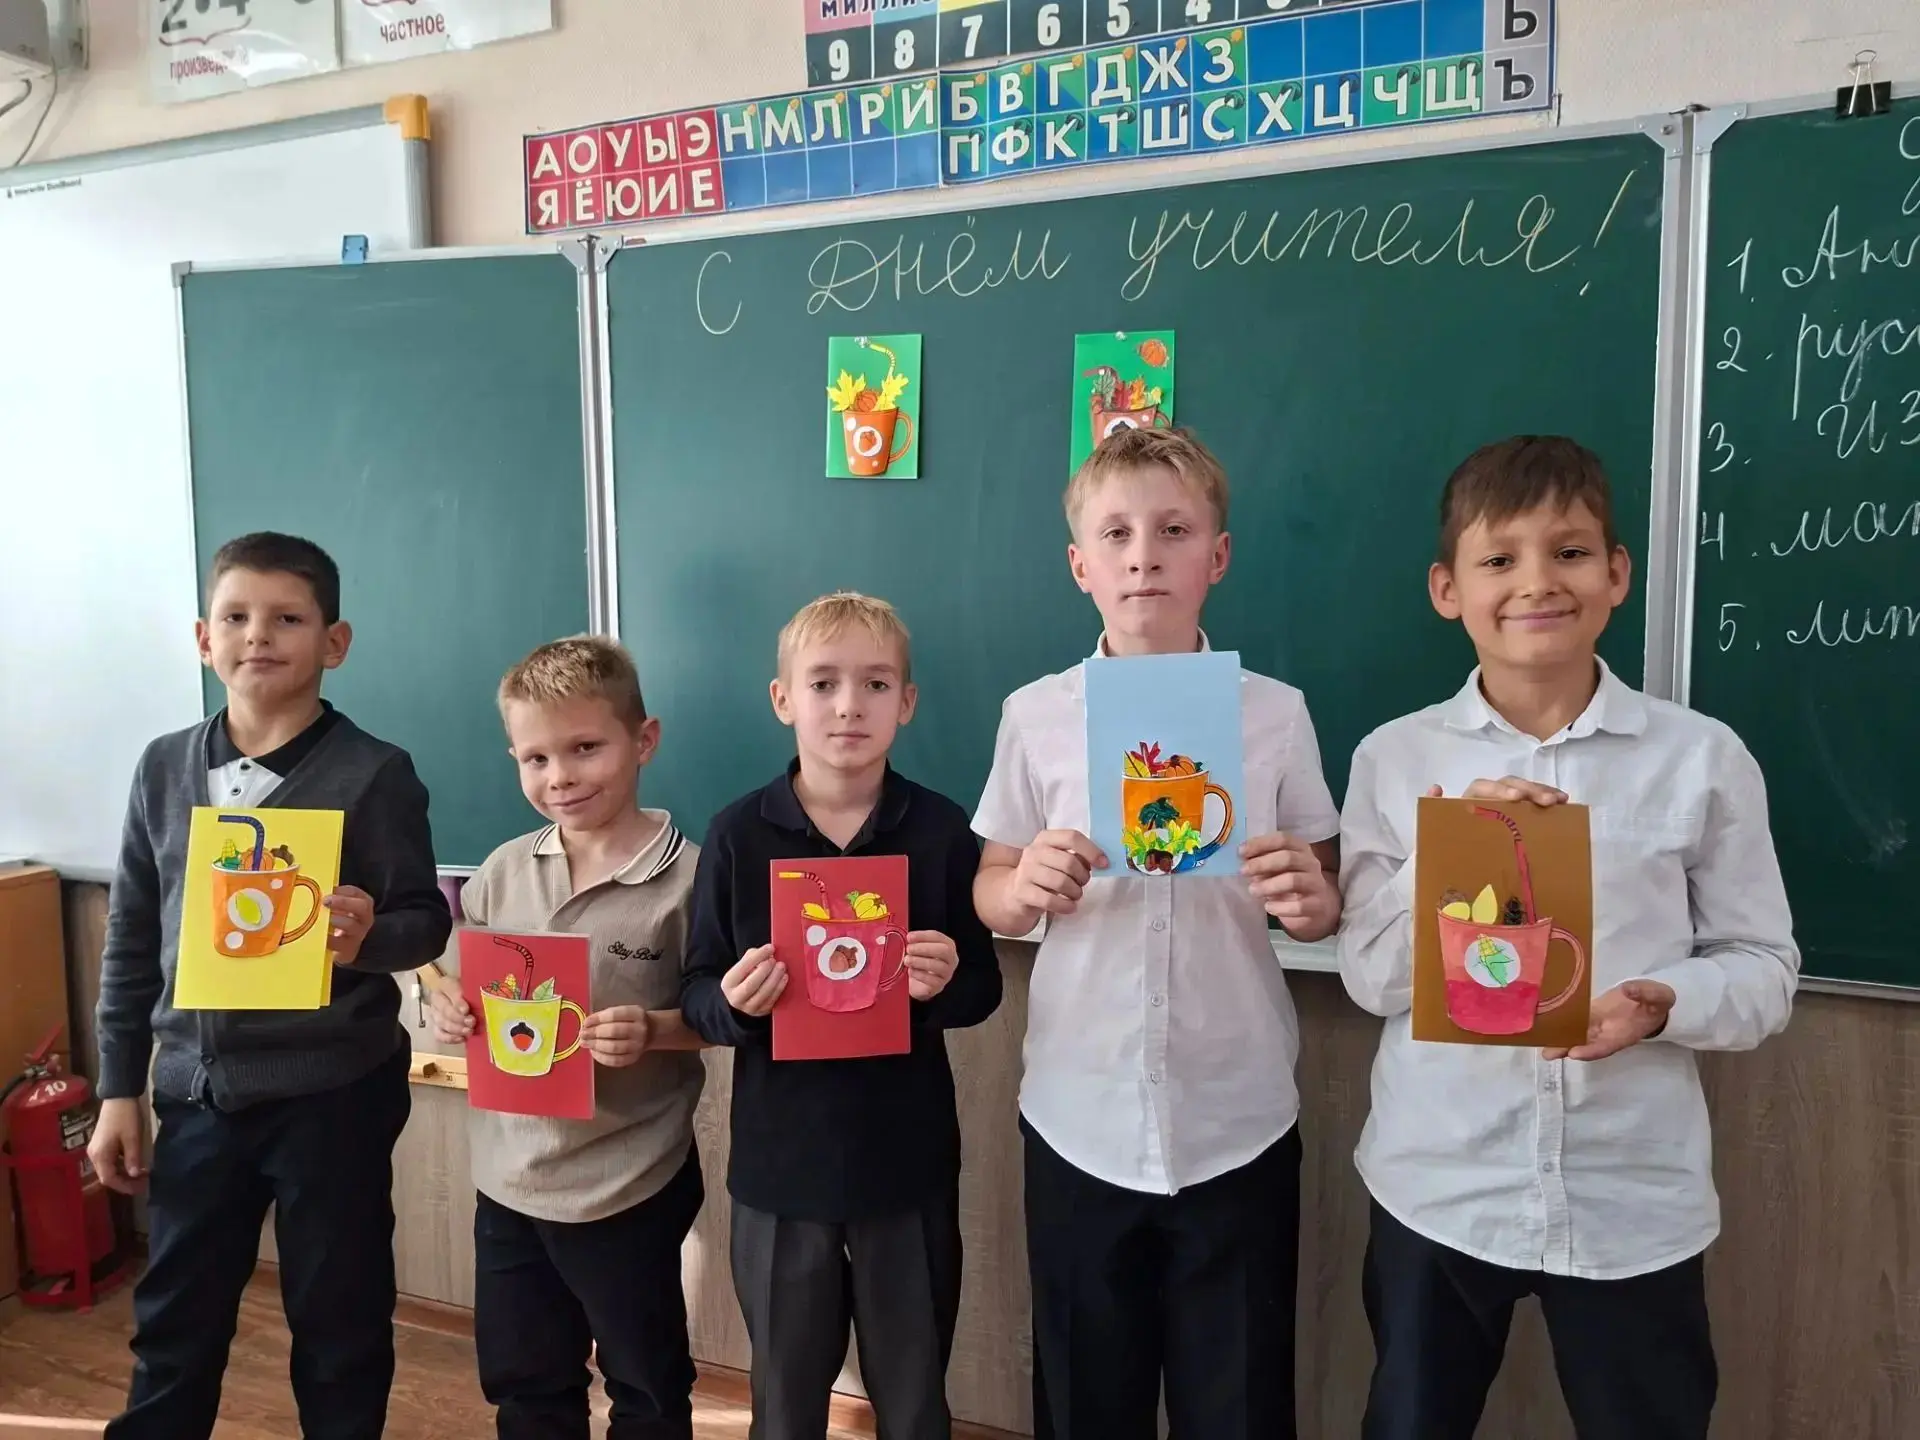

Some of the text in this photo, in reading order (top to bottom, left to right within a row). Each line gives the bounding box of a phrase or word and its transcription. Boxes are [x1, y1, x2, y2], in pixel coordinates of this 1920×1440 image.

[380, 13, 445, 44] частное
[828, 39, 850, 82] 9
[894, 29, 915, 70] 8
[961, 14, 984, 58] 7
[1037, 4, 1061, 46] 6
[1106, 0, 1131, 37] 5
[696, 169, 1636, 334] С Днём учителя!
[1792, 312, 1920, 421] рус
